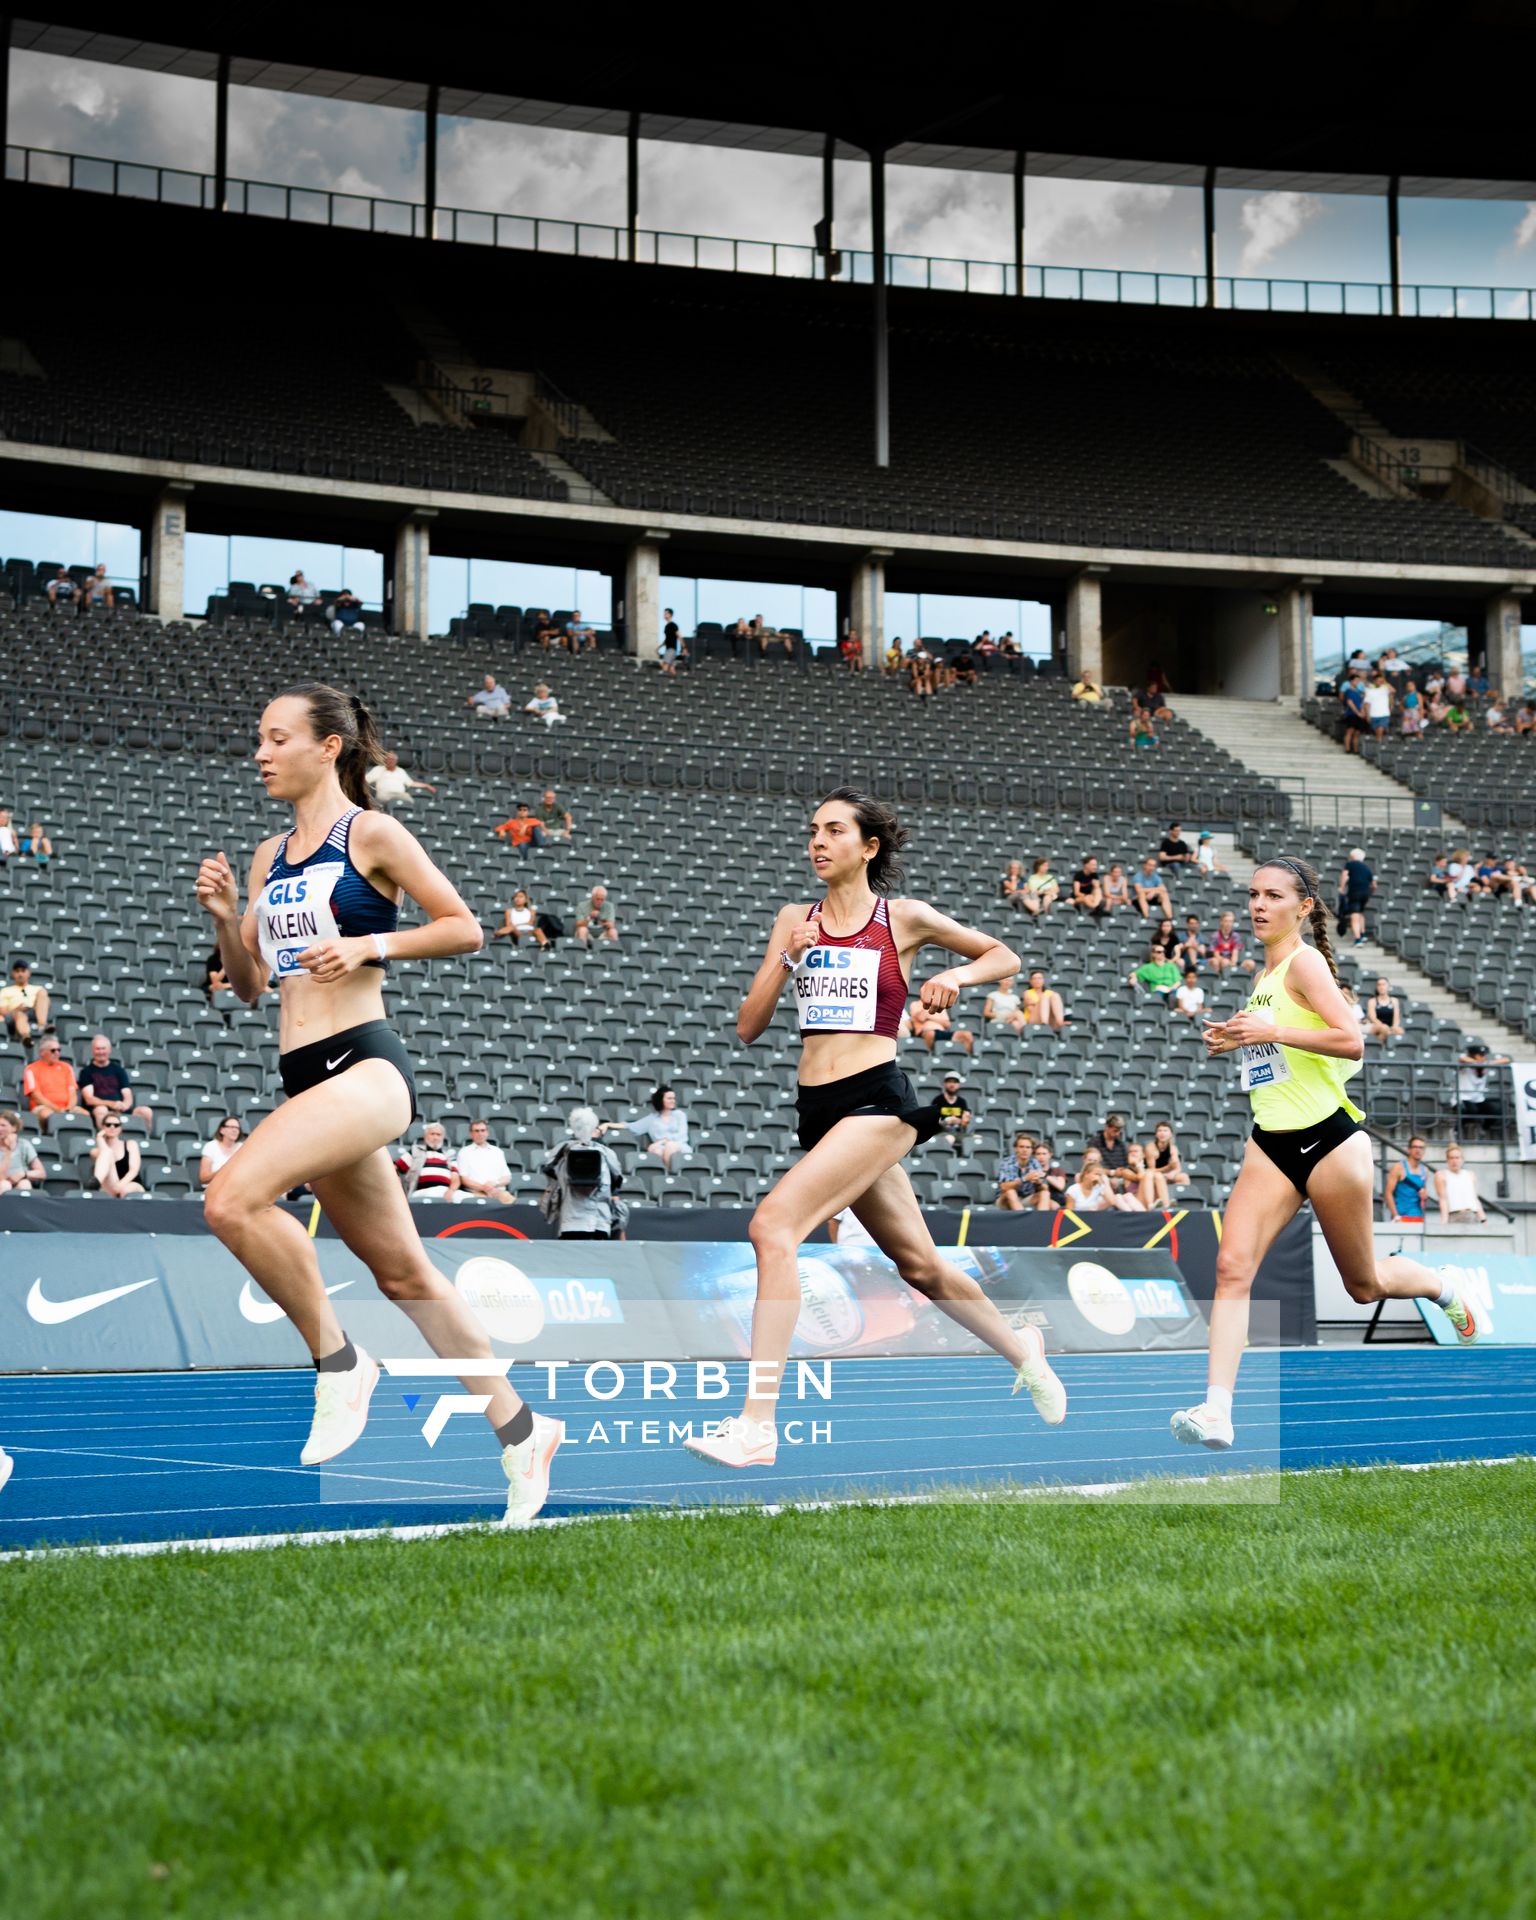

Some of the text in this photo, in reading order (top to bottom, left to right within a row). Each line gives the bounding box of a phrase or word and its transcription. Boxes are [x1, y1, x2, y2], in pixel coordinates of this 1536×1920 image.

[1400, 447, 1421, 463] 13
[165, 514, 181, 536] E
[268, 880, 308, 906] GLS
[267, 911, 319, 941] KLEIN
[805, 949, 852, 969] GLS
[796, 976, 869, 999] BENFARES
[822, 1009, 853, 1018] PLAN
[1254, 1067, 1272, 1079] PLAN
